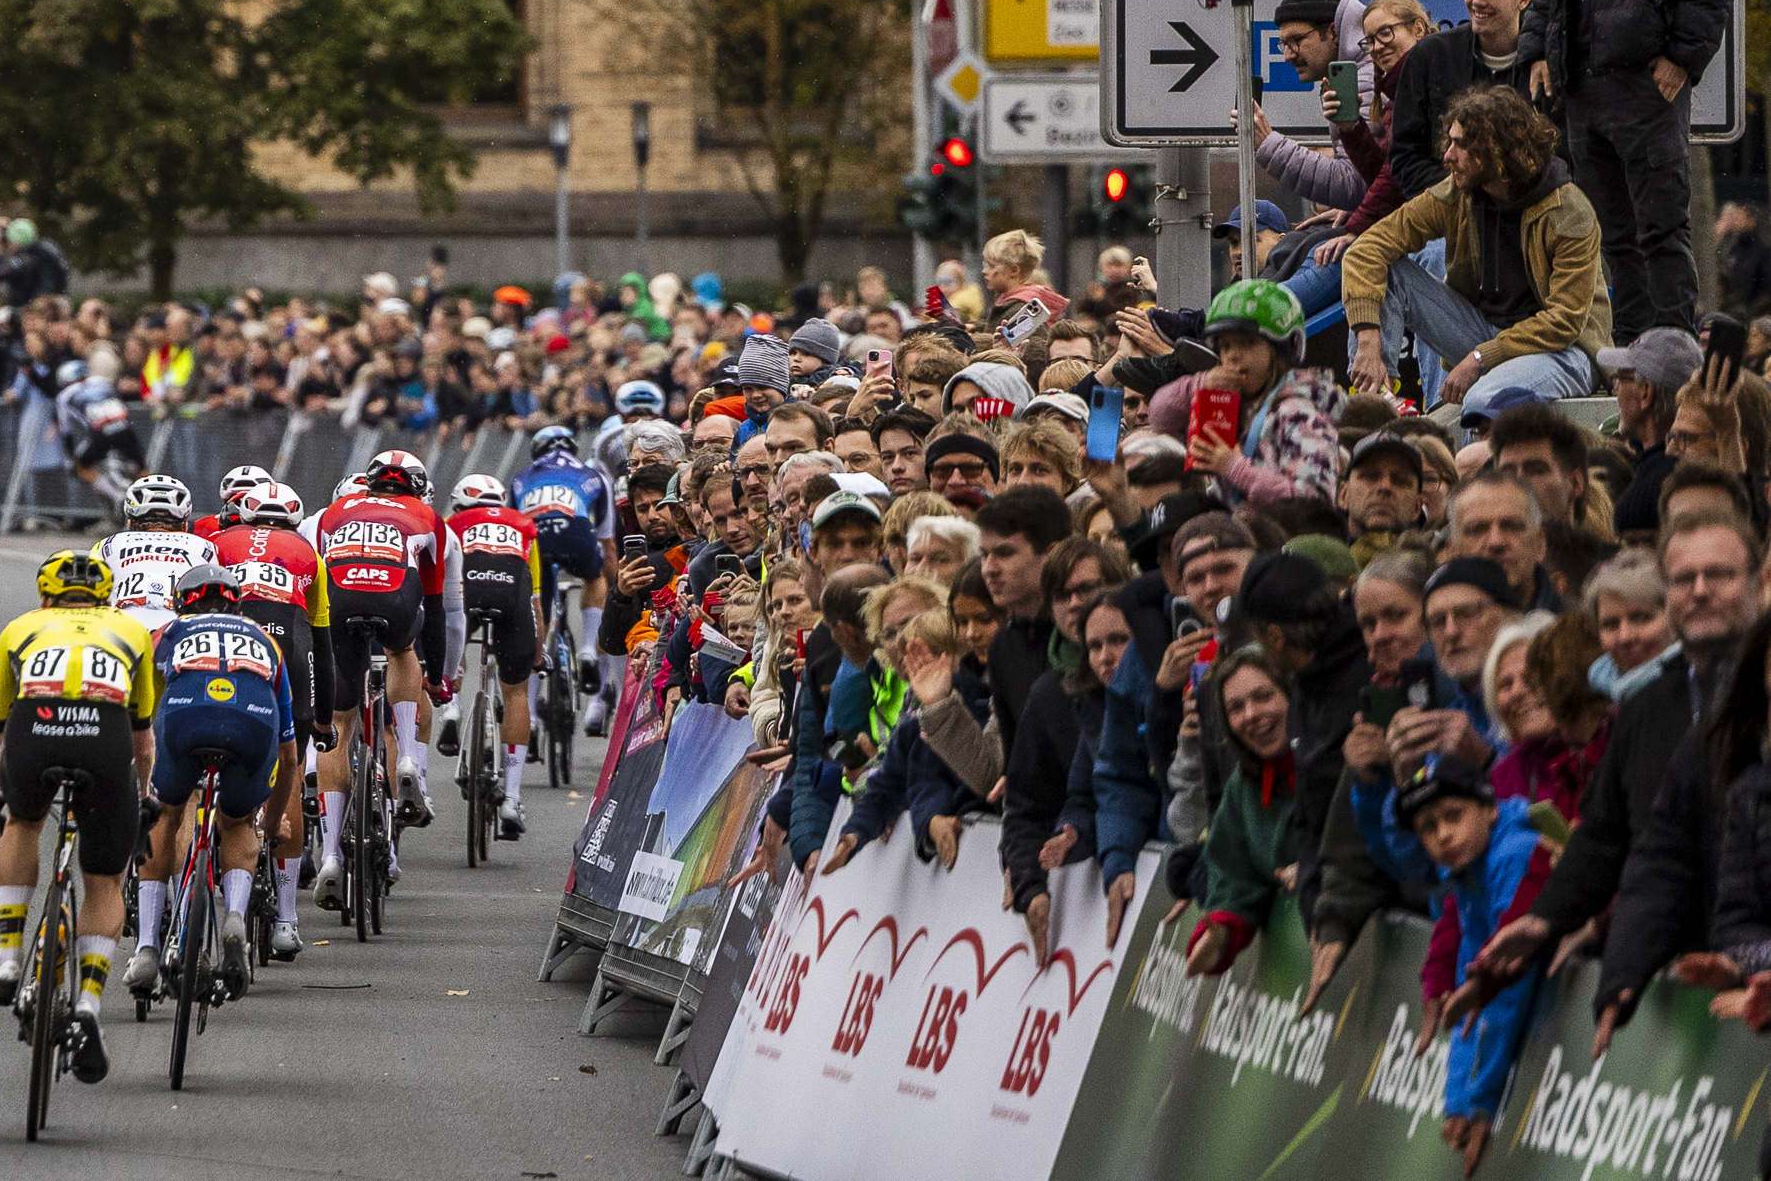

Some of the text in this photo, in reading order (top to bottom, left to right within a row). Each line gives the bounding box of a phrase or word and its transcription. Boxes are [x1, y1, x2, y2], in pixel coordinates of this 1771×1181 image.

[366, 523, 400, 548] 132
[467, 524, 491, 543] 34
[496, 525, 519, 546] 34
[259, 564, 287, 587] 35
[346, 567, 389, 581] CAPS
[466, 570, 515, 584] Cofidis
[180, 633, 264, 661] 26 26
[30, 648, 65, 677] 87
[57, 706, 101, 723] VISMA
[32, 721, 64, 736] lease
[75, 723, 101, 737] bike
[763, 952, 810, 1036] LBS
[831, 970, 884, 1058] LBS
[905, 983, 968, 1075] LBS
[999, 1005, 1061, 1098] LBS
